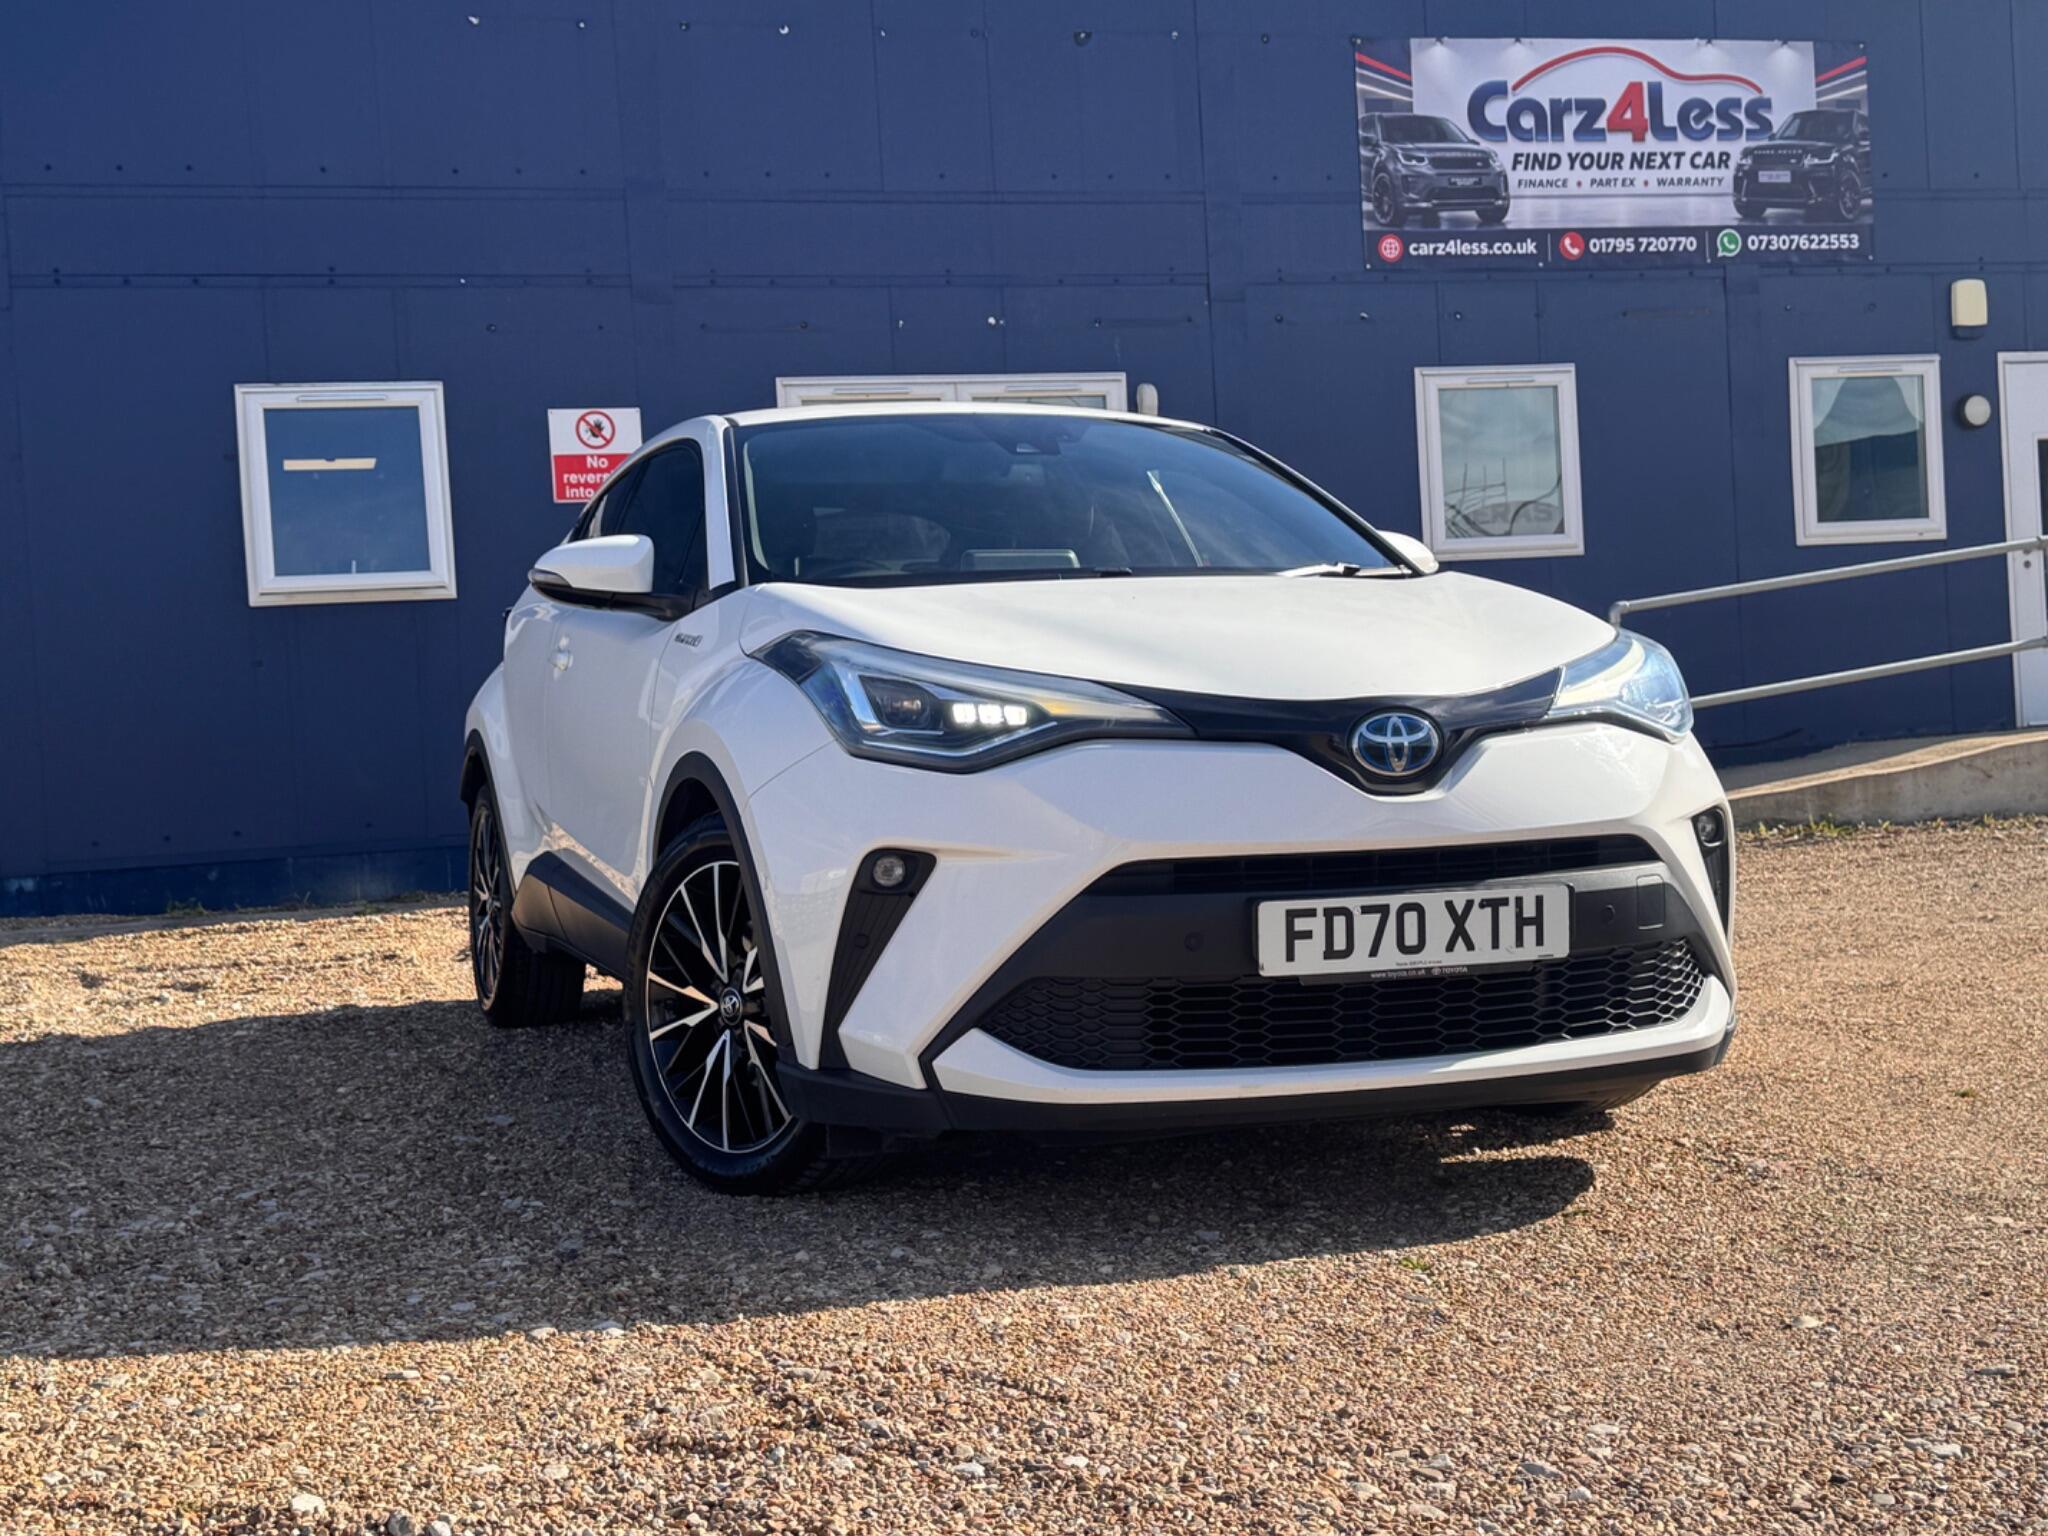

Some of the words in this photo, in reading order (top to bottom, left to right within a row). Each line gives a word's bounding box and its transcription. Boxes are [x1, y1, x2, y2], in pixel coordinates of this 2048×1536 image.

[1467, 80, 1774, 143] Carz4Less
[1511, 152, 1562, 171] FIND
[1567, 152, 1625, 170] YOUR
[1629, 152, 1686, 170] NEXT
[1690, 151, 1731, 170] CAR
[1517, 178, 1569, 189] FINANCE
[1590, 178, 1619, 188] PART
[1621, 178, 1636, 188] EX
[1656, 176, 1725, 188] WARRANTY
[1409, 238, 1537, 256] carz4less.co.uk
[1589, 238, 1635, 253] 01795
[1638, 236, 1697, 252] 720770
[1747, 233, 1859, 250] 07307622553
[586, 455, 608, 468] No
[563, 470, 615, 484] revers
[565, 485, 594, 498] into
[1285, 902, 1426, 962] FD70
[1444, 895, 1544, 953] XTH
